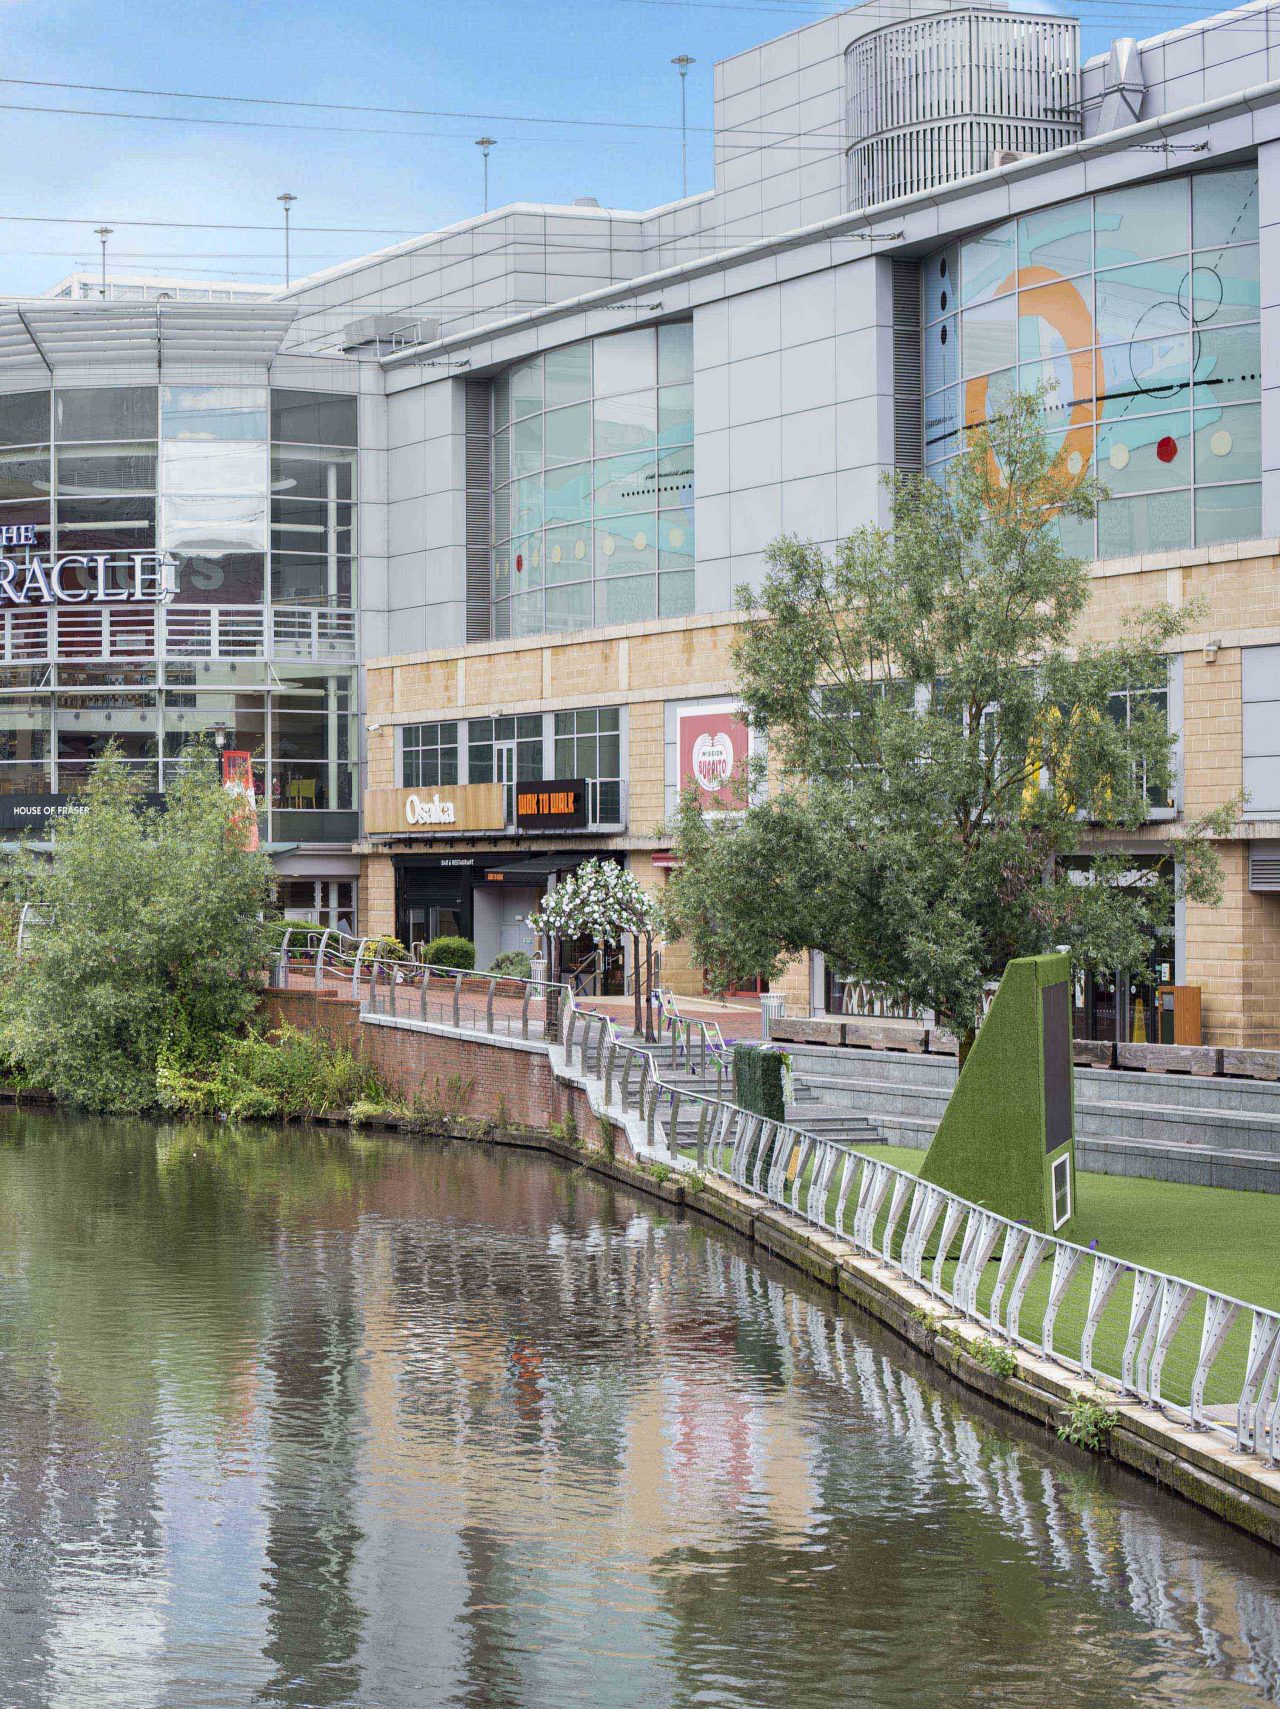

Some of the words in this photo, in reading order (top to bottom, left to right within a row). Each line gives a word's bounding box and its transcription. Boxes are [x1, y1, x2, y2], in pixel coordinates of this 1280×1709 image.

[702, 750, 723, 758] MISSION
[13, 806, 42, 815] HOUSE
[43, 806, 56, 815] OF
[57, 806, 90, 815] FRASER
[405, 793, 457, 825] Osaka
[518, 793, 538, 815] WOK
[539, 793, 549, 814] TO
[550, 792, 575, 814] WALK
